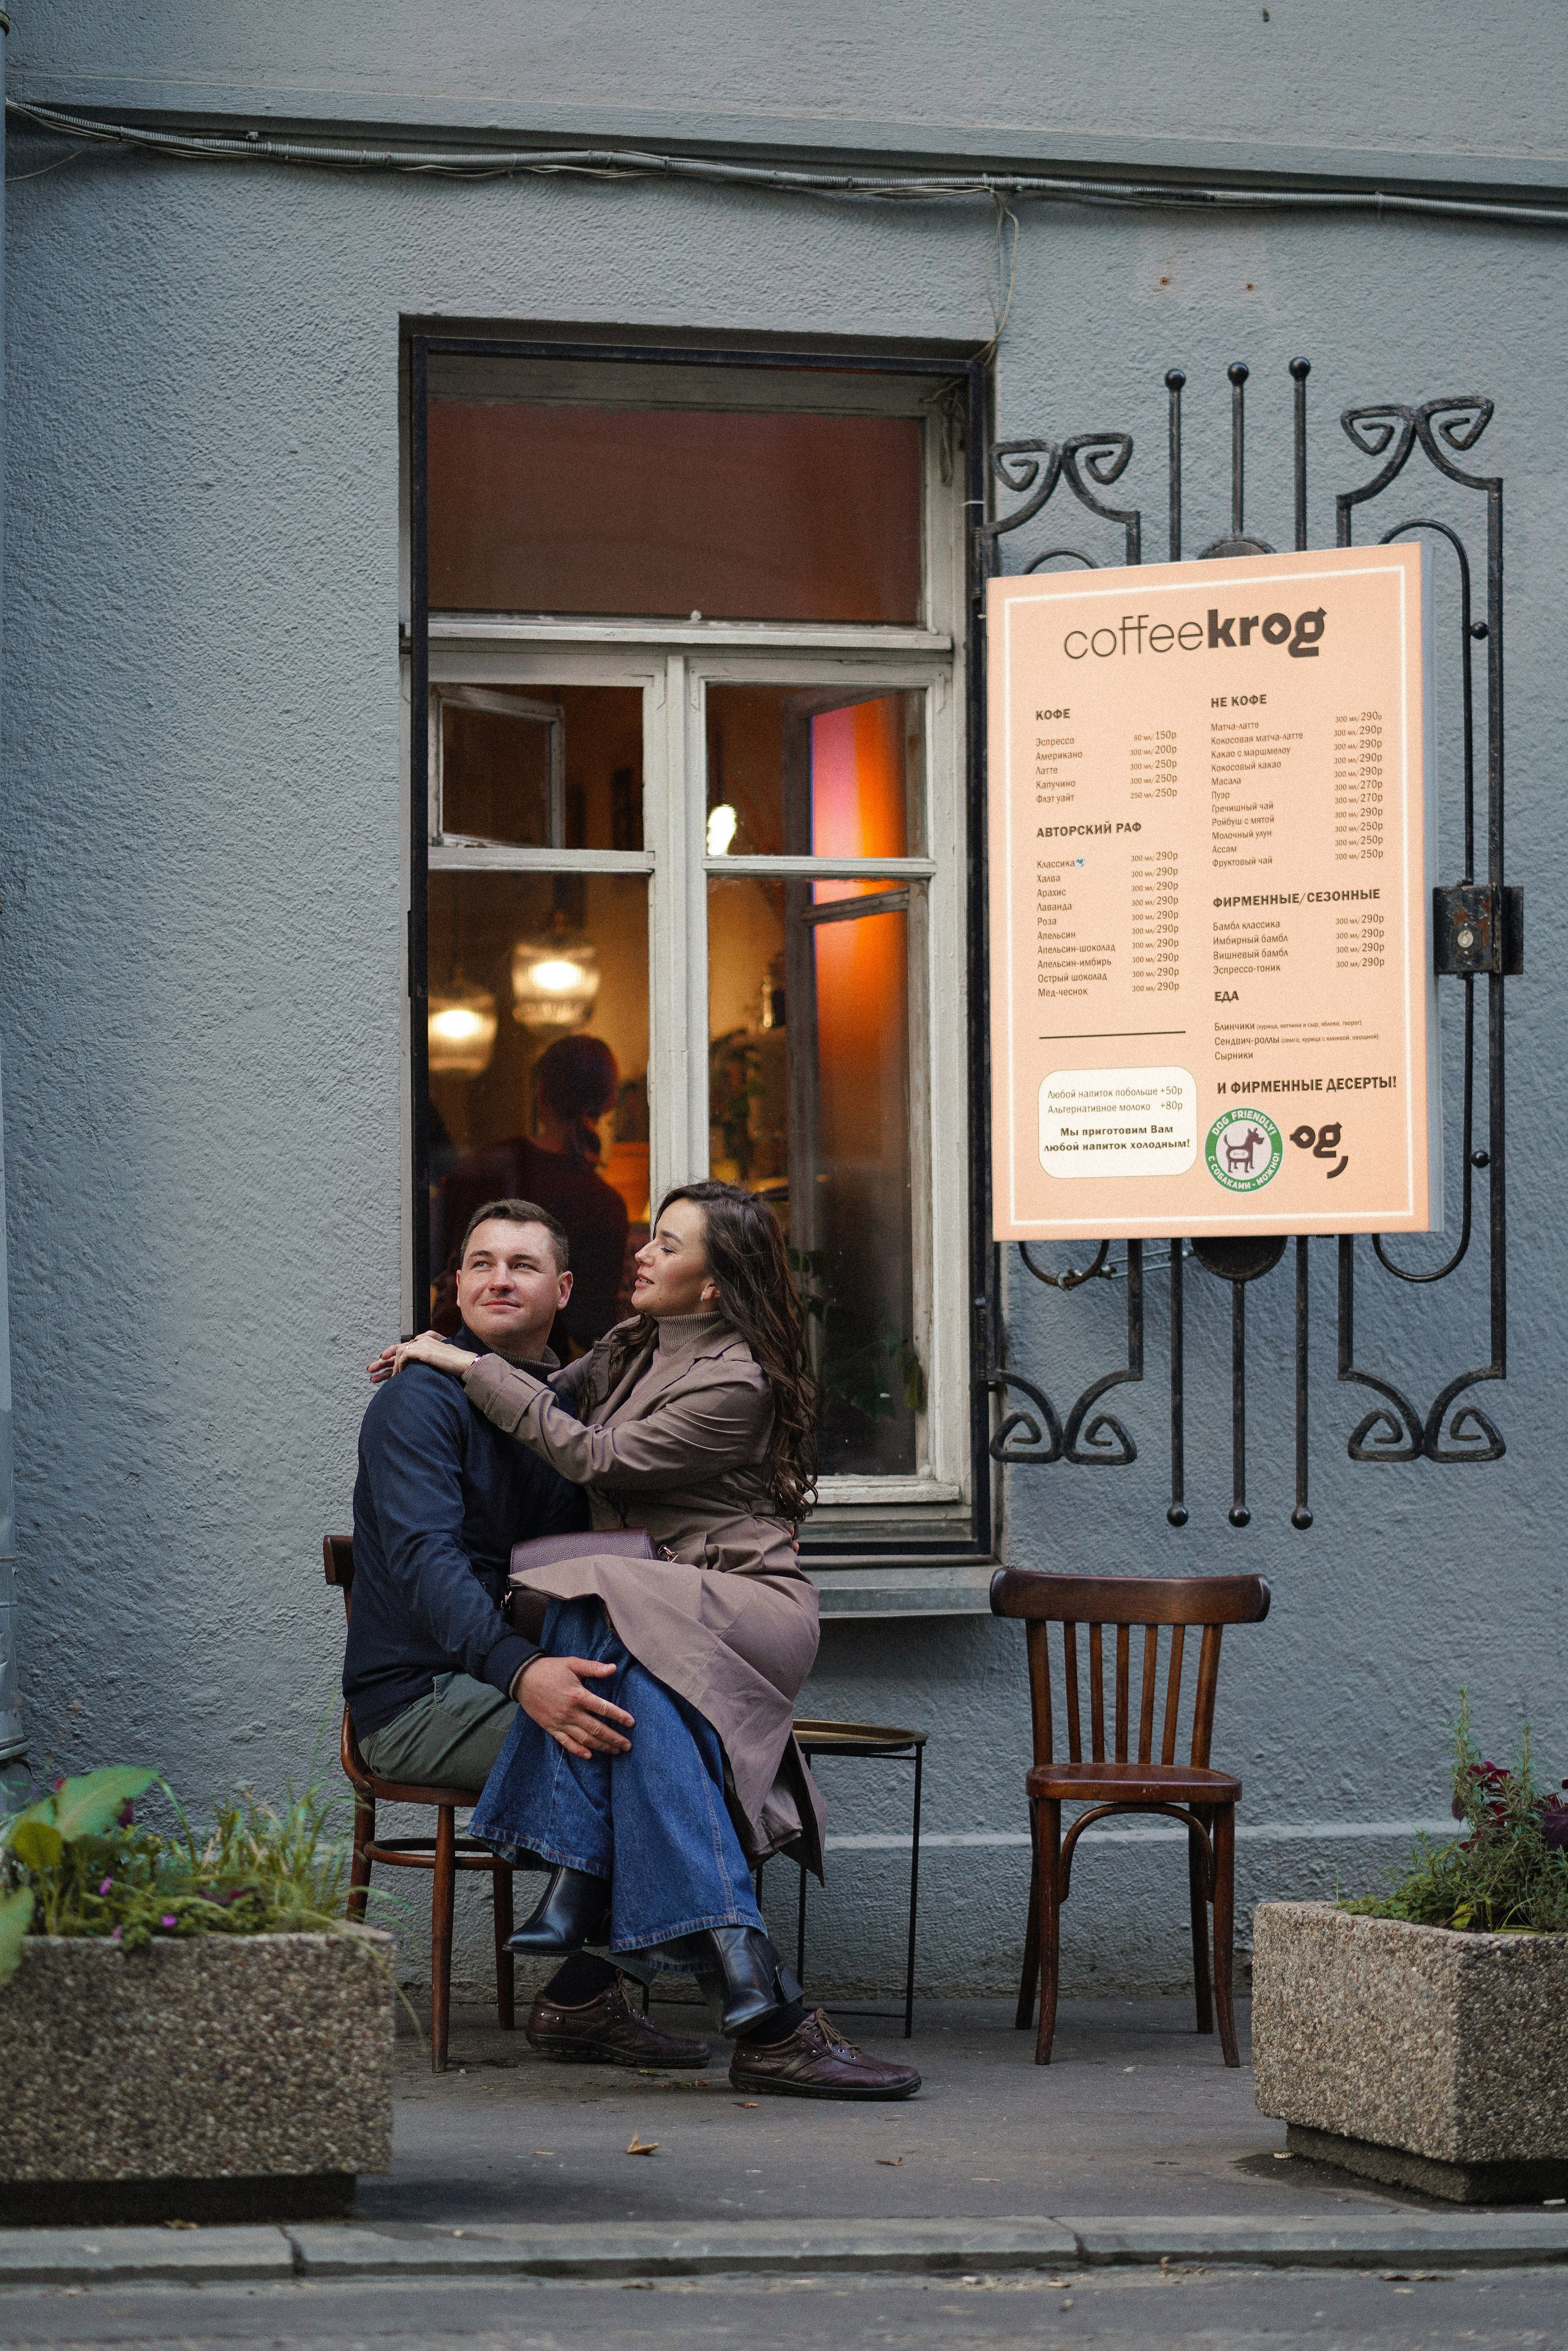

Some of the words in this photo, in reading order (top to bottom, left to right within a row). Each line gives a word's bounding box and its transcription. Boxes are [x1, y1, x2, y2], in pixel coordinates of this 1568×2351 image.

[1063, 606, 1327, 659] coffeekrog
[1210, 697, 1227, 708] НЕ
[1231, 694, 1267, 706] КОФЕ
[1036, 709, 1070, 720] КОФЕ
[1210, 722, 1259, 731] Матча-латте
[1036, 738, 1074, 747] Эспрессо
[1211, 736, 1253, 745] Кокосовая
[1256, 733, 1303, 742] матча-латте
[1036, 751, 1083, 761] Американо
[1211, 750, 1235, 758] Какао
[1244, 747, 1290, 757] маршмелоу
[1212, 761, 1256, 772] Кокосовый
[1258, 761, 1281, 769] какао
[1036, 780, 1076, 789] Капучино
[1212, 777, 1241, 785] Масала
[1036, 794, 1054, 803] Флэт
[1057, 794, 1074, 804] уайт
[1212, 791, 1230, 800] Пуэр
[1212, 802, 1257, 813] Гречишный
[1259, 801, 1273, 810] чай
[1212, 817, 1242, 827] Ройбуш
[1251, 815, 1274, 824] мятой
[1037, 821, 1112, 837] АВТОРСКИЙ
[1116, 822, 1141, 833] РАФ
[1212, 829, 1253, 840] Молочный
[1256, 831, 1272, 839] улун
[1212, 845, 1237, 854] Ассам
[1037, 859, 1075, 869] Классика
[1212, 857, 1256, 868] Фруктовый
[1258, 856, 1272, 865] чай
[1037, 889, 1066, 897] Арахис
[1213, 889, 1380, 908] ФИРМЕННЫЕ/СЕЗОННЫЕ
[1037, 903, 1072, 911] Лаванда
[1038, 917, 1057, 926] Роза
[1213, 921, 1240, 931] Бамбл
[1242, 920, 1280, 929] классика
[1038, 931, 1076, 940] Апельсин
[1213, 935, 1259, 946] Имбирный
[1262, 934, 1287, 943] бамбл
[1038, 943, 1115, 954] Апельсин-шоколад
[1213, 949, 1259, 960] Вишневый
[1262, 948, 1288, 957] бамбл
[1038, 957, 1111, 968] Апельсин-имбирь
[1213, 965, 1280, 975] Эспрессо-тоник
[1038, 973, 1068, 983] Острый
[1071, 973, 1107, 982] шоколад
[1038, 987, 1088, 997] Мед-чеснок
[1215, 991, 1239, 1003] ЕДА
[1215, 1022, 1254, 1031] Блинчики
[1215, 1036, 1280, 1046] Сендвич-роллы
[1215, 1051, 1253, 1061] Сырники
[1217, 1082, 1226, 1094] И
[1231, 1079, 1322, 1094] ФИРМЕННЫЕ
[1326, 1076, 1396, 1092] ДЕСЕРТЫ!
[1047, 1090, 1076, 1099] Любой
[1079, 1089, 1112, 1098] напиток
[1115, 1087, 1158, 1096] побольше
[1160, 1085, 1183, 1096] +50р
[1048, 1105, 1116, 1114] Альтернативное
[1160, 1101, 1183, 1111] +80р
[1212, 1117, 1229, 1136] DOG
[1231, 1110, 1277, 1136] FRIENDLY!
[1060, 1128, 1079, 1136] Мы
[1082, 1126, 1147, 1137] приготовим
[1044, 1141, 1079, 1152] любой
[1083, 1142, 1126, 1150] напиток
[1130, 1139, 1189, 1149] холодным!
[1211, 1164, 1251, 1189] СОБАКАМИ
[1257, 1152, 1280, 1186] МОЖНО!
